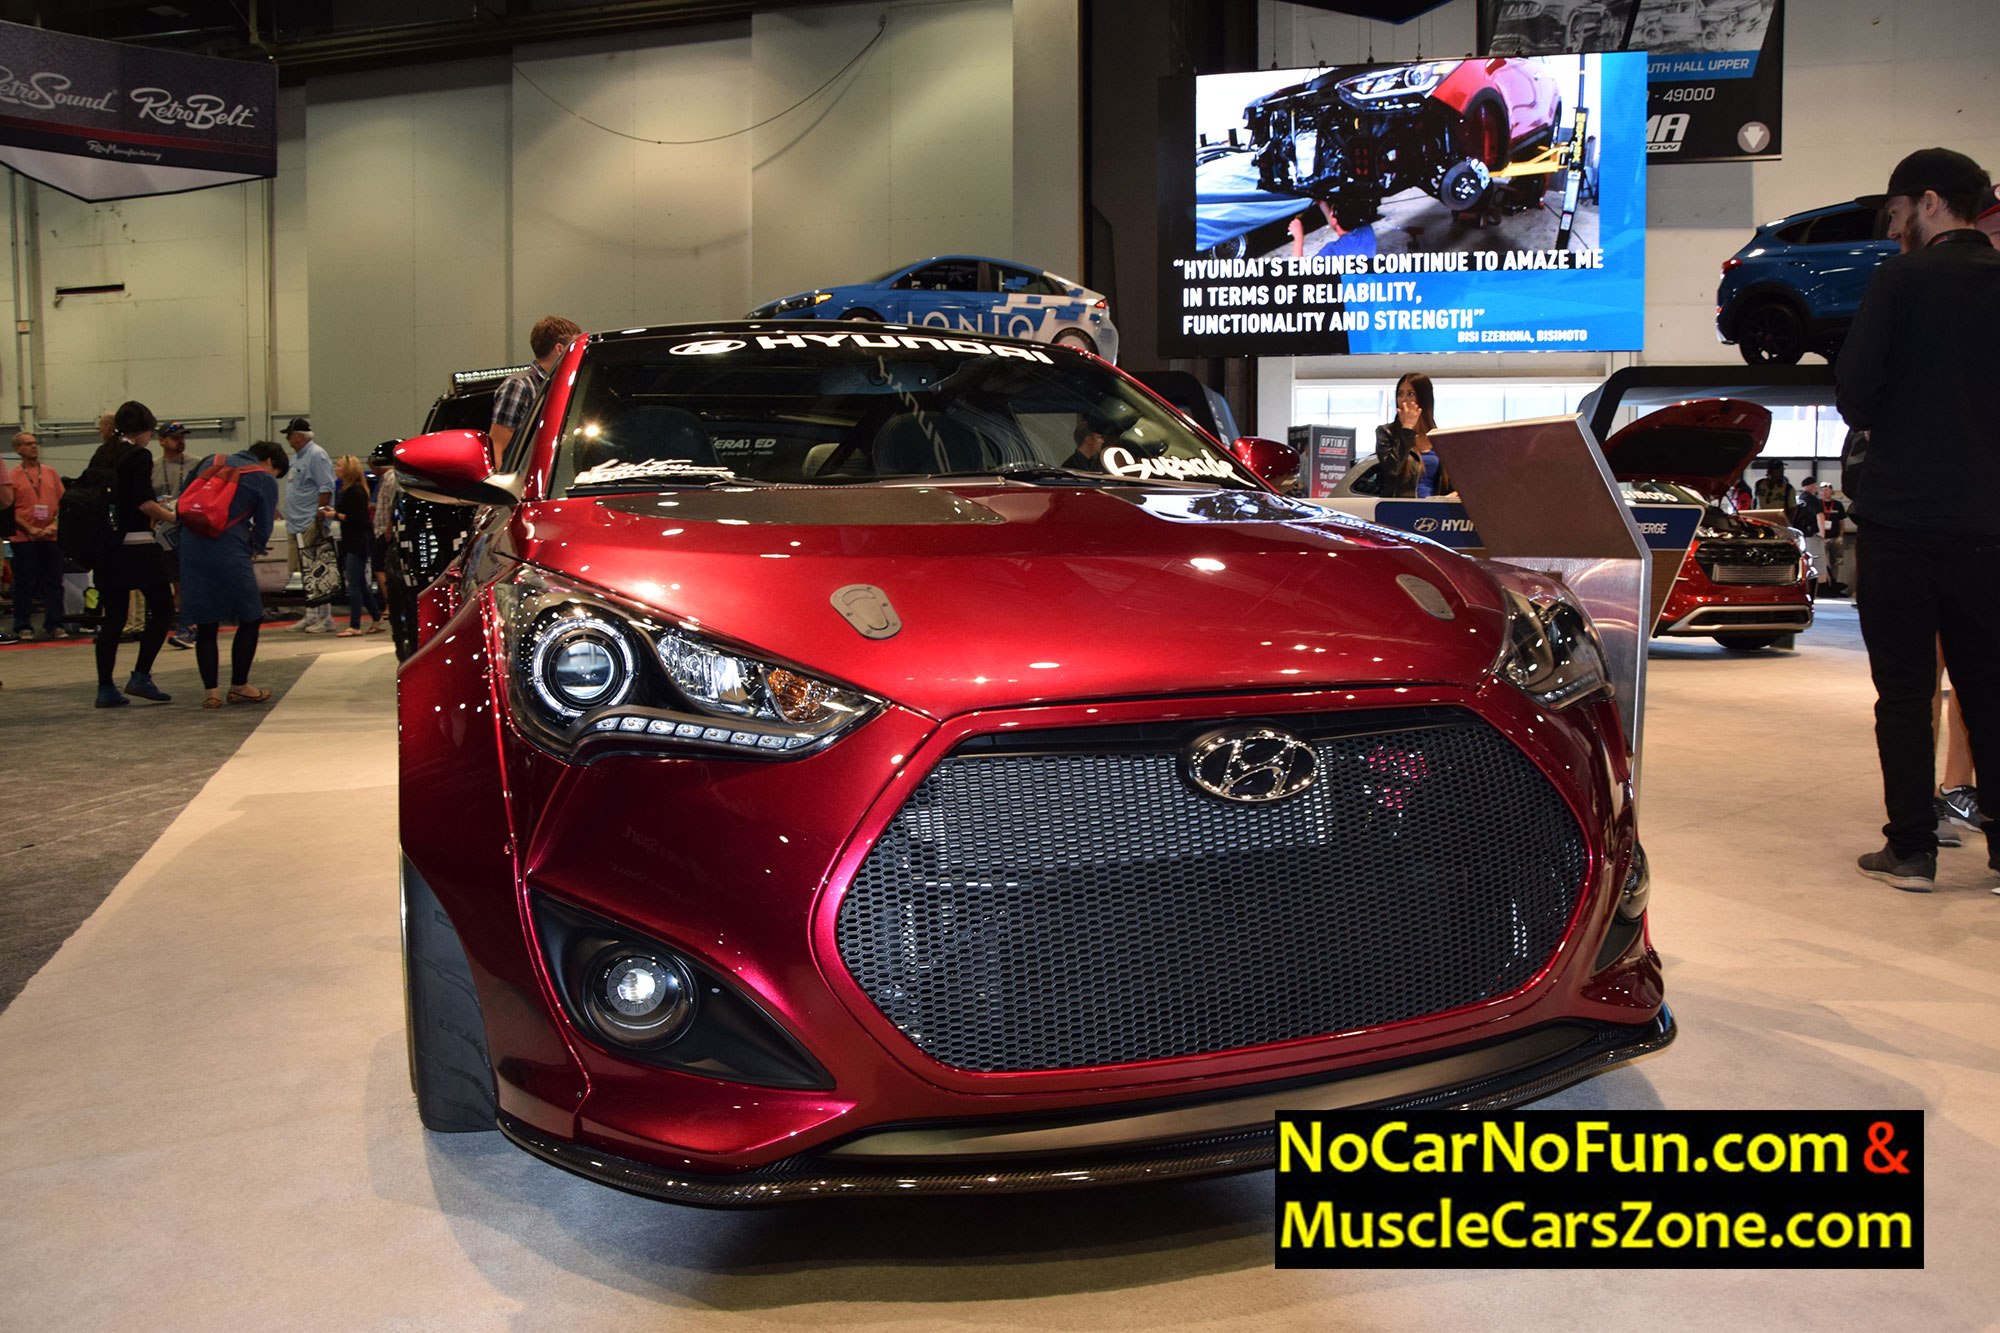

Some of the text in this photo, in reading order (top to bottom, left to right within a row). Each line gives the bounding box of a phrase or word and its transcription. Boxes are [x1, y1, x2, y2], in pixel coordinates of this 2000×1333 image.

[1673, 61, 1704, 72] HALL
[1708, 58, 1750, 71] UPPER
[1663, 87, 1716, 102] 49000
[130, 87, 256, 129] RetroBelt
[1288, 254, 1368, 277] ENGINES
[1373, 251, 1469, 273] CONTINUE
[1473, 251, 1499, 272] TO
[1503, 249, 1570, 271] AMAZE
[1575, 248, 1604, 269] ME
[1183, 281, 1422, 307] IN TERMS OF RELIABILITY,
[907, 311, 1034, 340] IONIQ
[1182, 312, 1325, 335] FUNCTIONALITY
[1329, 311, 1370, 332] AND
[1457, 331, 1480, 343] BISI
[1536, 329, 1588, 342] BISIMOTO
[755, 334, 1055, 365] HYUNDAI
[1321, 437, 1348, 449] OPTIMA
